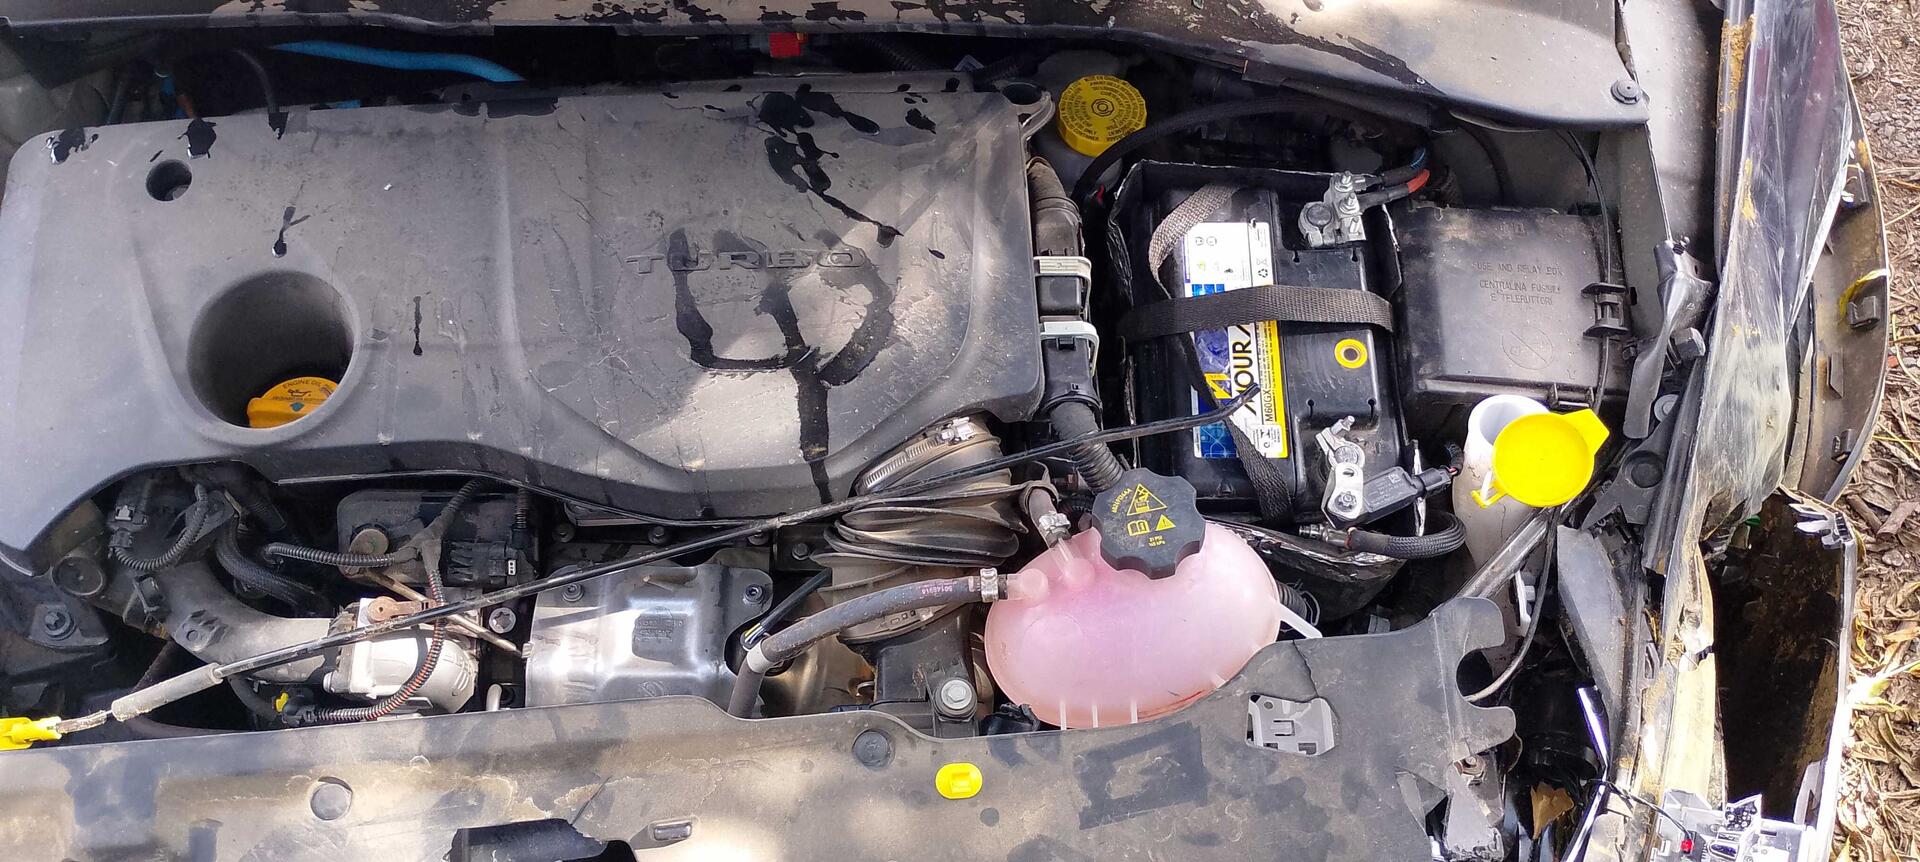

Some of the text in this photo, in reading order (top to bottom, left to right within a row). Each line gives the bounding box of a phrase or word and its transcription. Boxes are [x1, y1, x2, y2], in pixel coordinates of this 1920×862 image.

[625, 248, 867, 274] TURBO
[1498, 263, 1513, 273] AND
[1517, 263, 1543, 274] RELAY
[1479, 280, 1527, 292] CENTRALINA
[282, 379, 310, 389] ENGINE
[1262, 389, 1274, 422] M60GX
